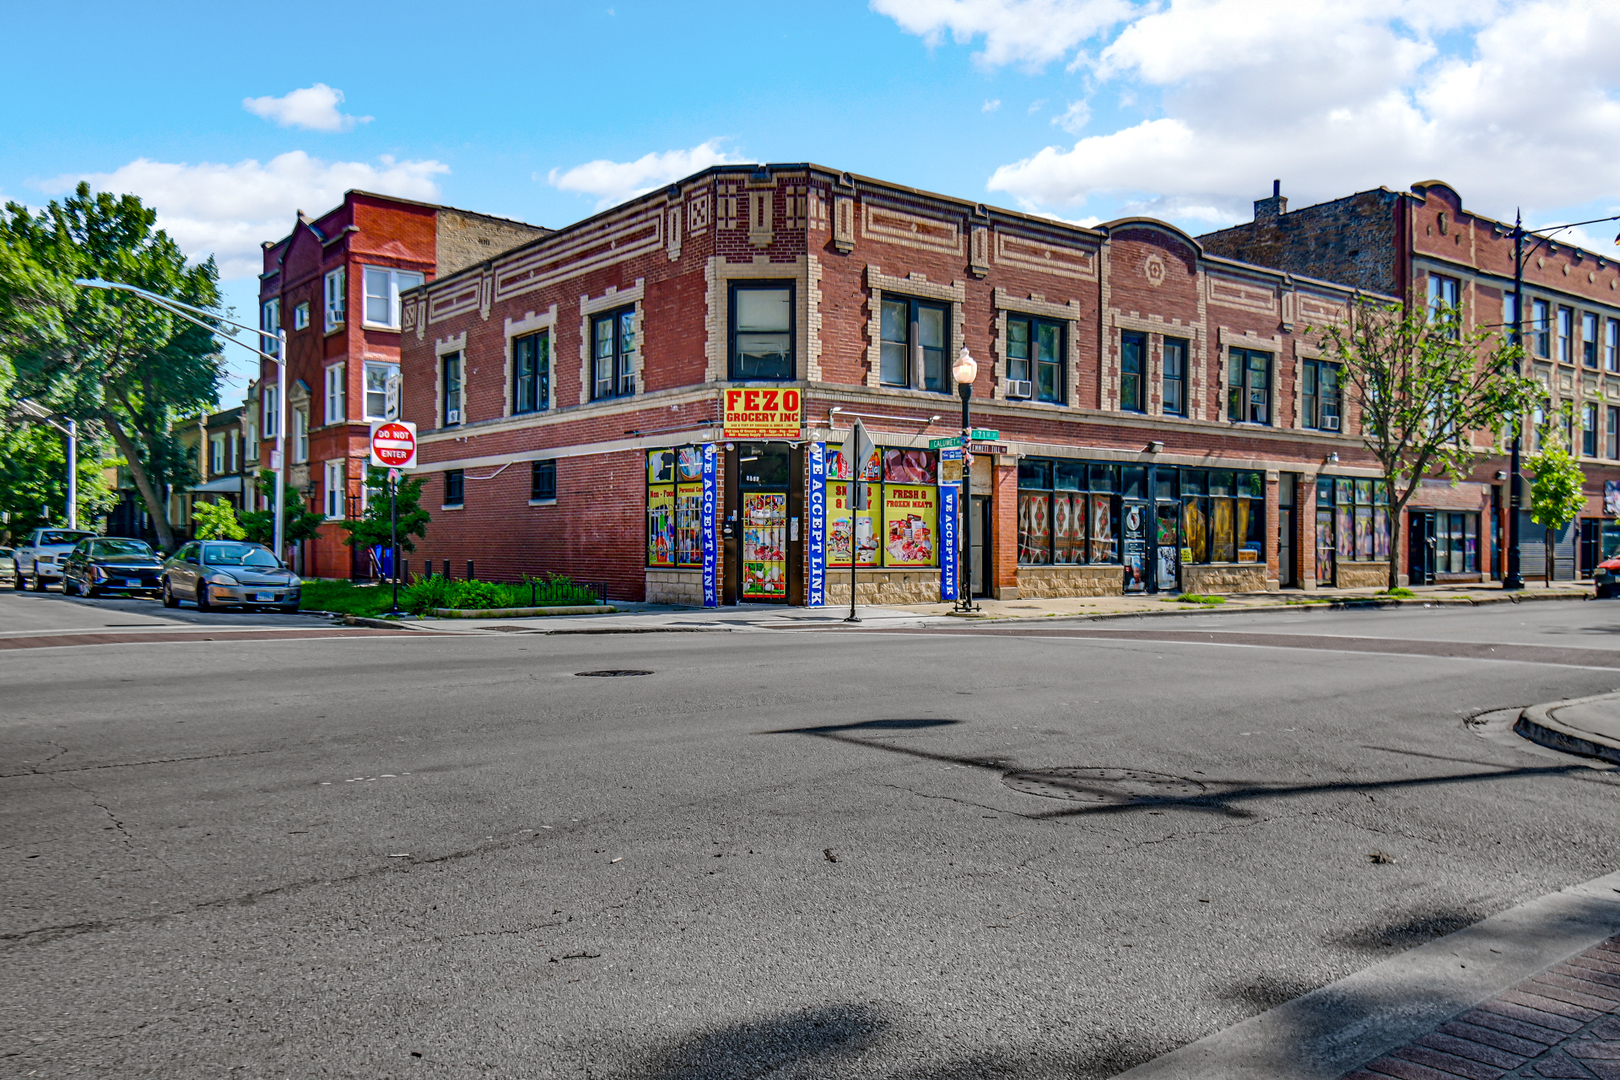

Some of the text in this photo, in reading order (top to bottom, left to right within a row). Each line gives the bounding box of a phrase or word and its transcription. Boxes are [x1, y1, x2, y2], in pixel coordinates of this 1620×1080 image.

[727, 390, 799, 412] FEZO
[726, 412, 799, 422] GROCERY INC
[378, 430, 409, 439] DO NOT
[933, 438, 956, 448] CALUMET
[972, 444, 989, 452] EMMETT
[992, 445, 1000, 453] TILL
[381, 450, 407, 458] ENTER
[679, 486, 695, 494] Personal
[893, 489, 926, 499] FRESH &
[836, 499, 842, 509] &
[887, 500, 910, 508] FROZEN
[946, 494, 953, 512] WE
[703, 446, 714, 602] WE ACCEPT LINK
[811, 447, 823, 604] WE ACCEPT LINK
